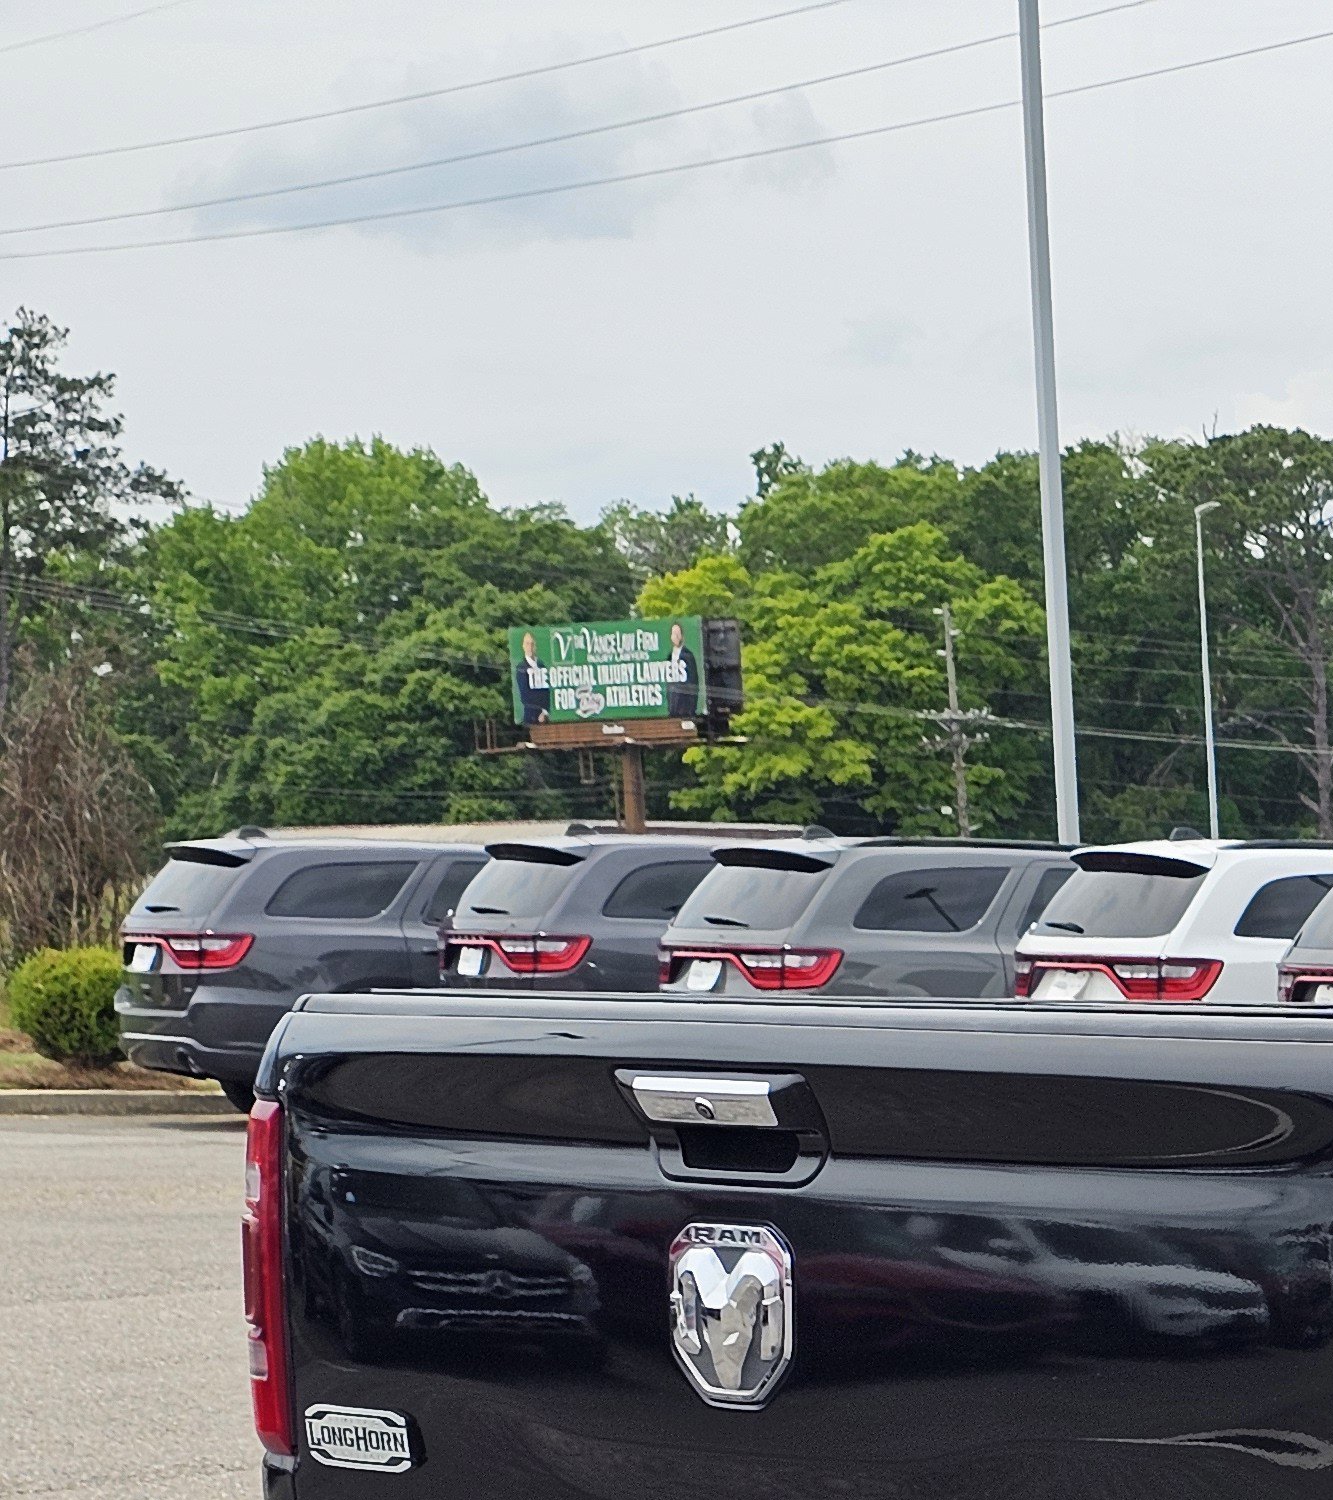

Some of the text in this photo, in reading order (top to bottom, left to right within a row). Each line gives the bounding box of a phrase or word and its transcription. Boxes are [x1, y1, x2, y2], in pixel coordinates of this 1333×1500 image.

[527, 659, 688, 689] THE OFFICIAL INJURY LAWYERS
[554, 688, 577, 710] FOR
[606, 684, 663, 707] ATHLETICS
[694, 1226, 762, 1245] RAM
